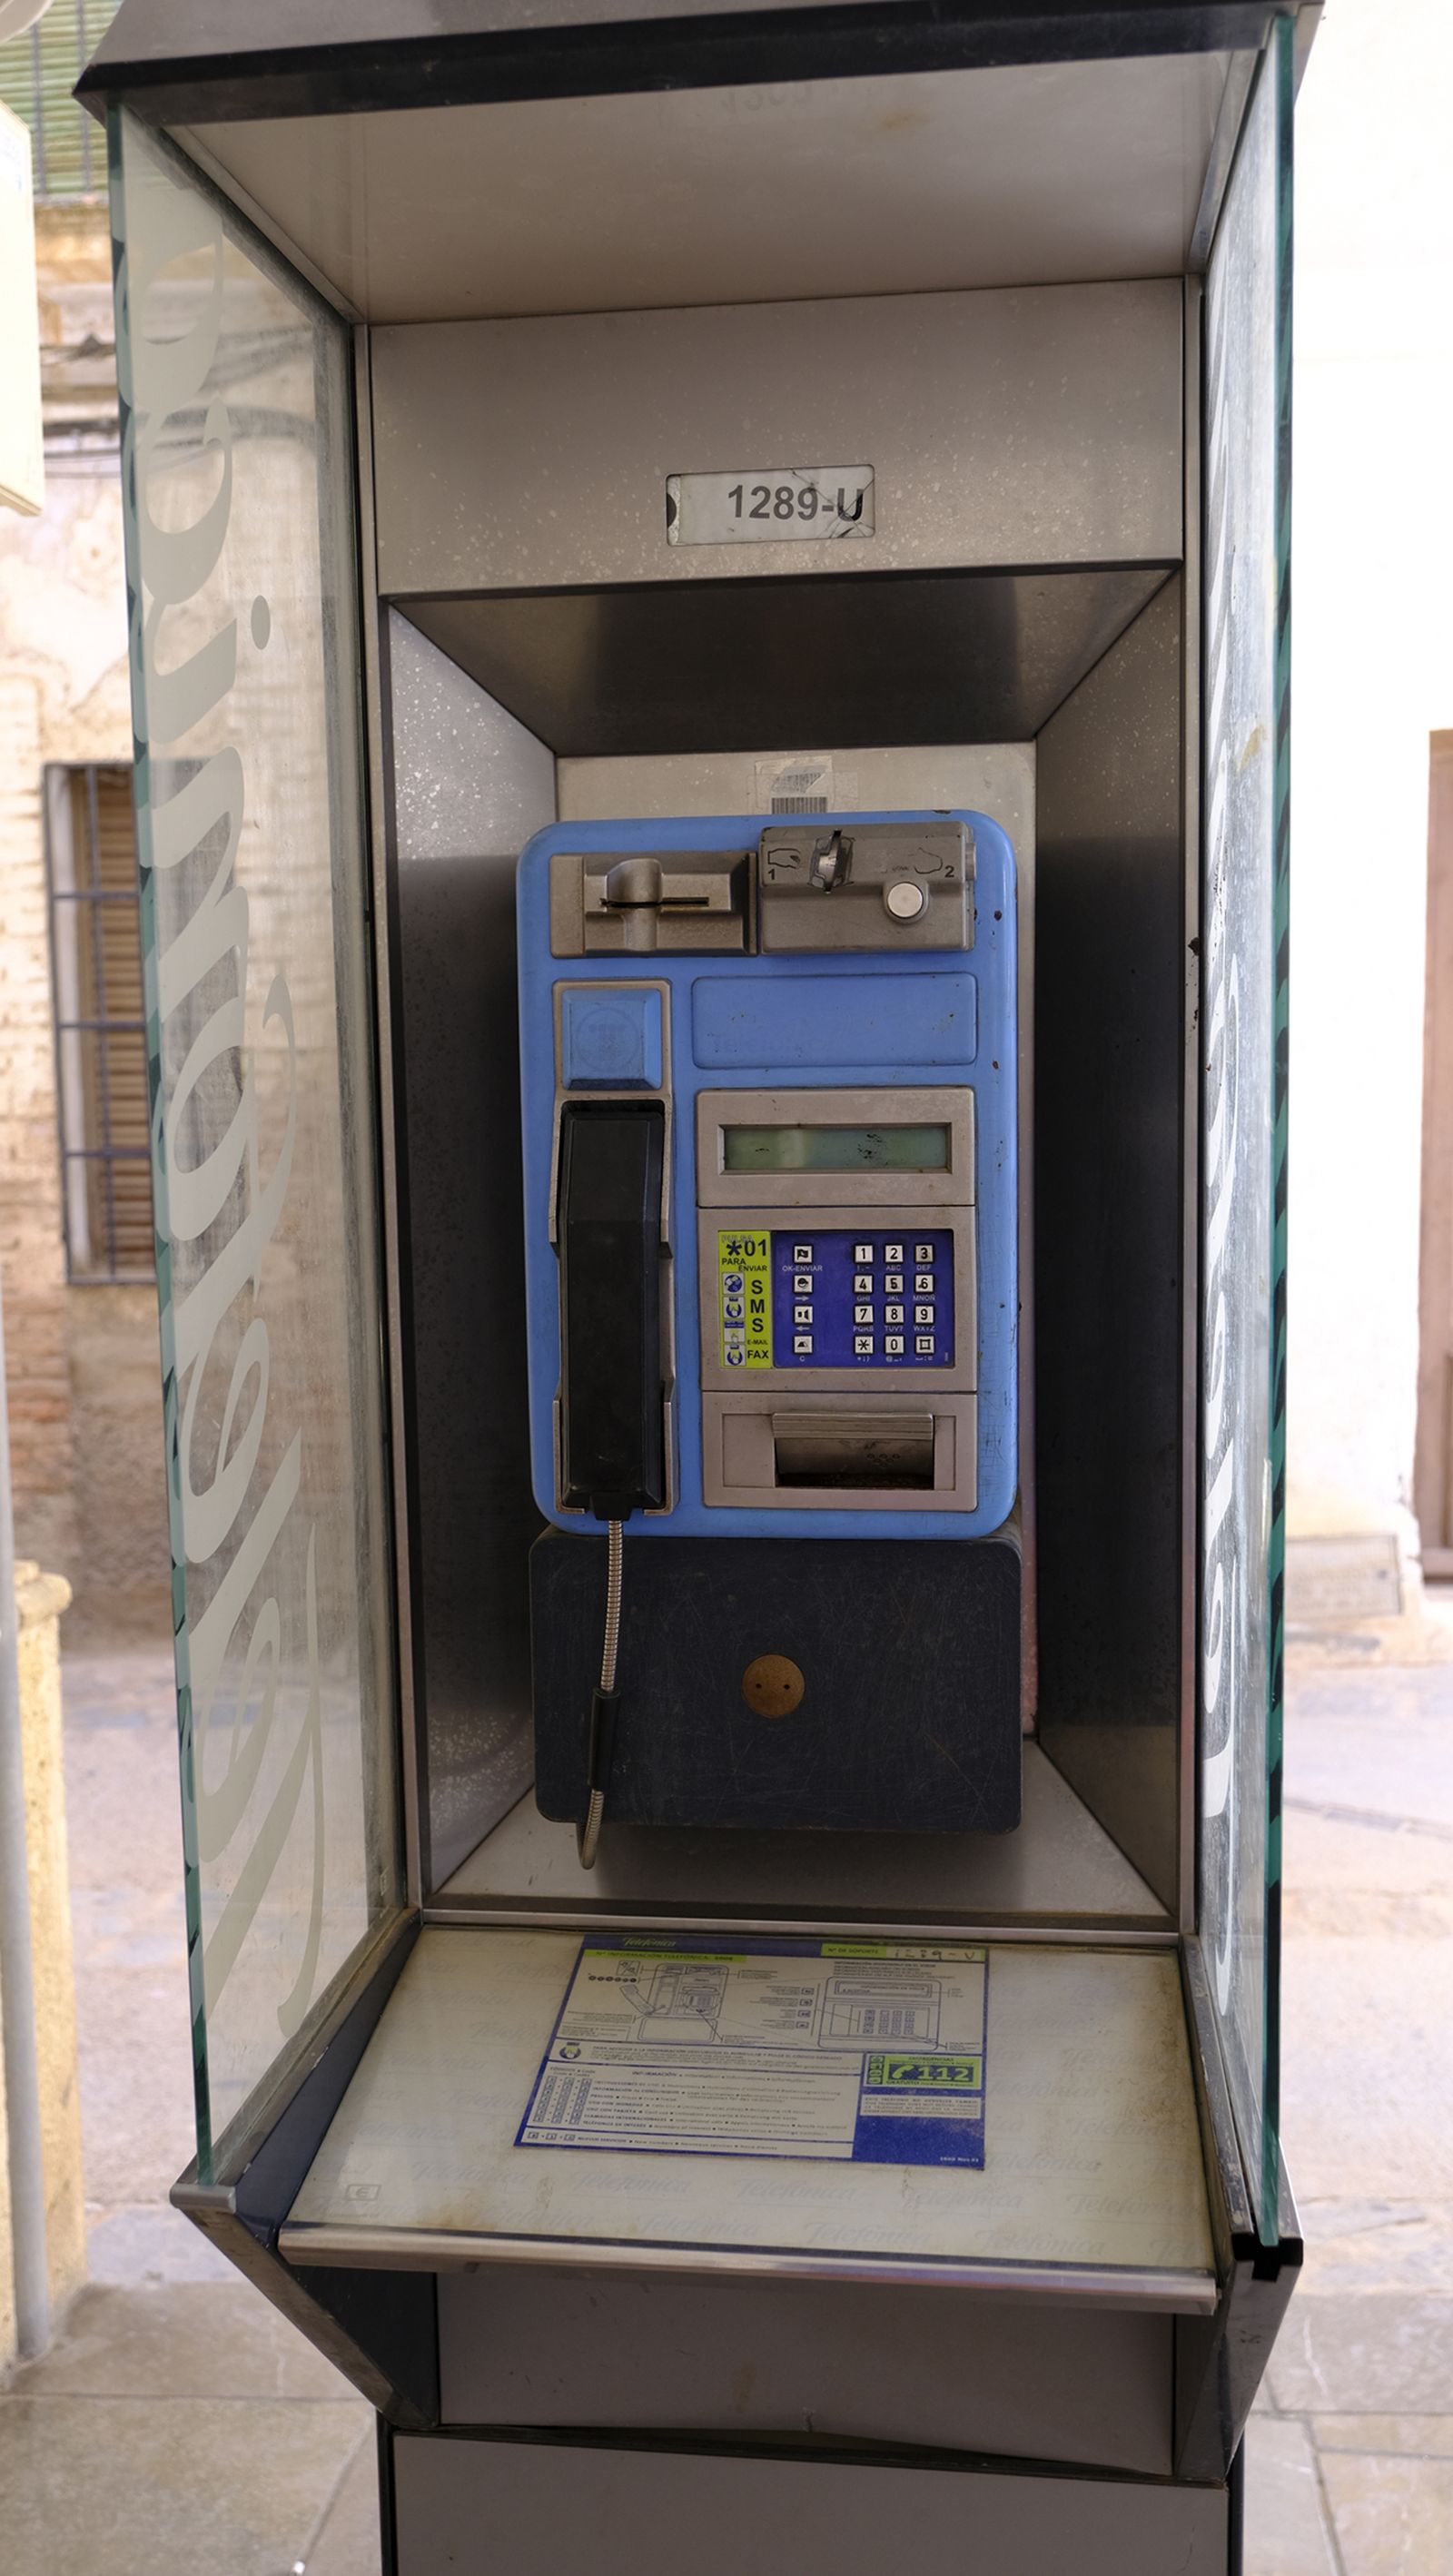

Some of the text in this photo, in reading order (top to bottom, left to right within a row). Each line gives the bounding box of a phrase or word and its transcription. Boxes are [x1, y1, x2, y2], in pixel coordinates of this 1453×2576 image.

[728, 485, 865, 522] 1289-U
[767, 867, 776, 881] 1
[944, 865, 955, 878] 2
[862, 1248, 866, 1259] 1
[890, 1248, 898, 1259] 2
[920, 1248, 928, 1259] 3
[859, 1278, 867, 1289] 4
[890, 1278, 898, 1289] 5
[920, 1278, 929, 1289] 6
[860, 1308, 868, 1320] 7
[891, 1308, 898, 1320] 8
[920, 1308, 928, 1320] 9
[891, 1338, 898, 1350] 0
[746, 1350, 770, 1359] FAX
[619, 1937, 677, 1948] Telefónica
[916, 2065, 969, 2081] 112
